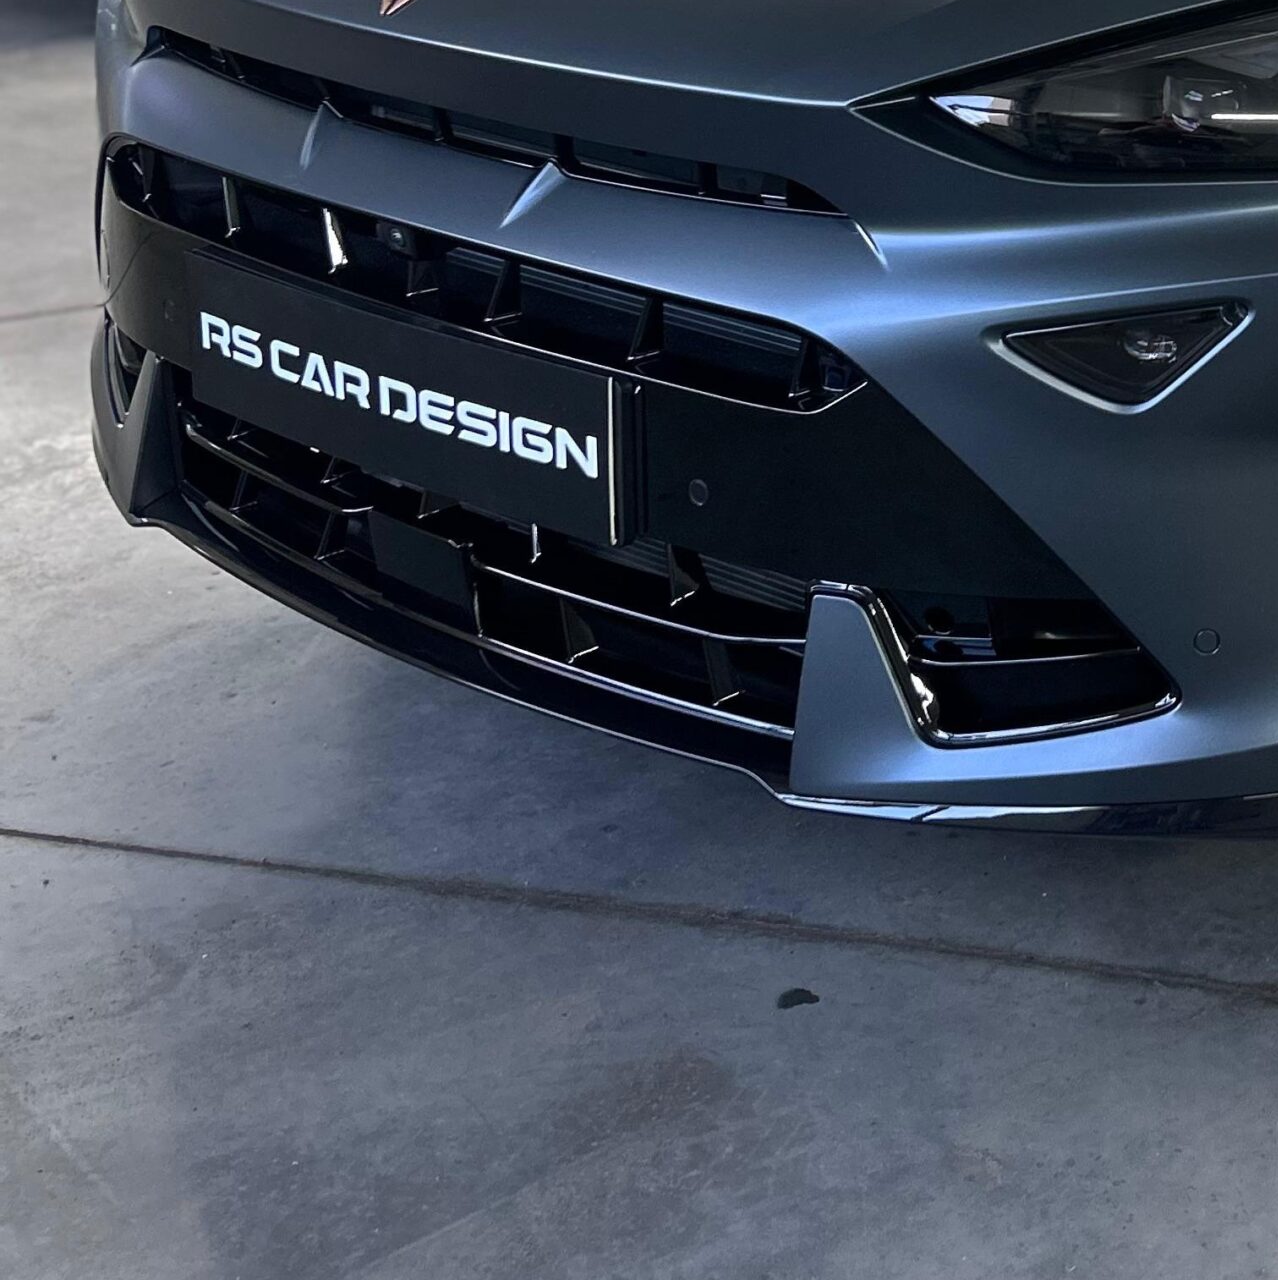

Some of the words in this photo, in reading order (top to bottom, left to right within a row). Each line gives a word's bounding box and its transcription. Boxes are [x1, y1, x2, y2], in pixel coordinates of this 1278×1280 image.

[200, 311, 263, 369] RS
[270, 339, 371, 410] CAR
[379, 375, 599, 479] DESIGN
